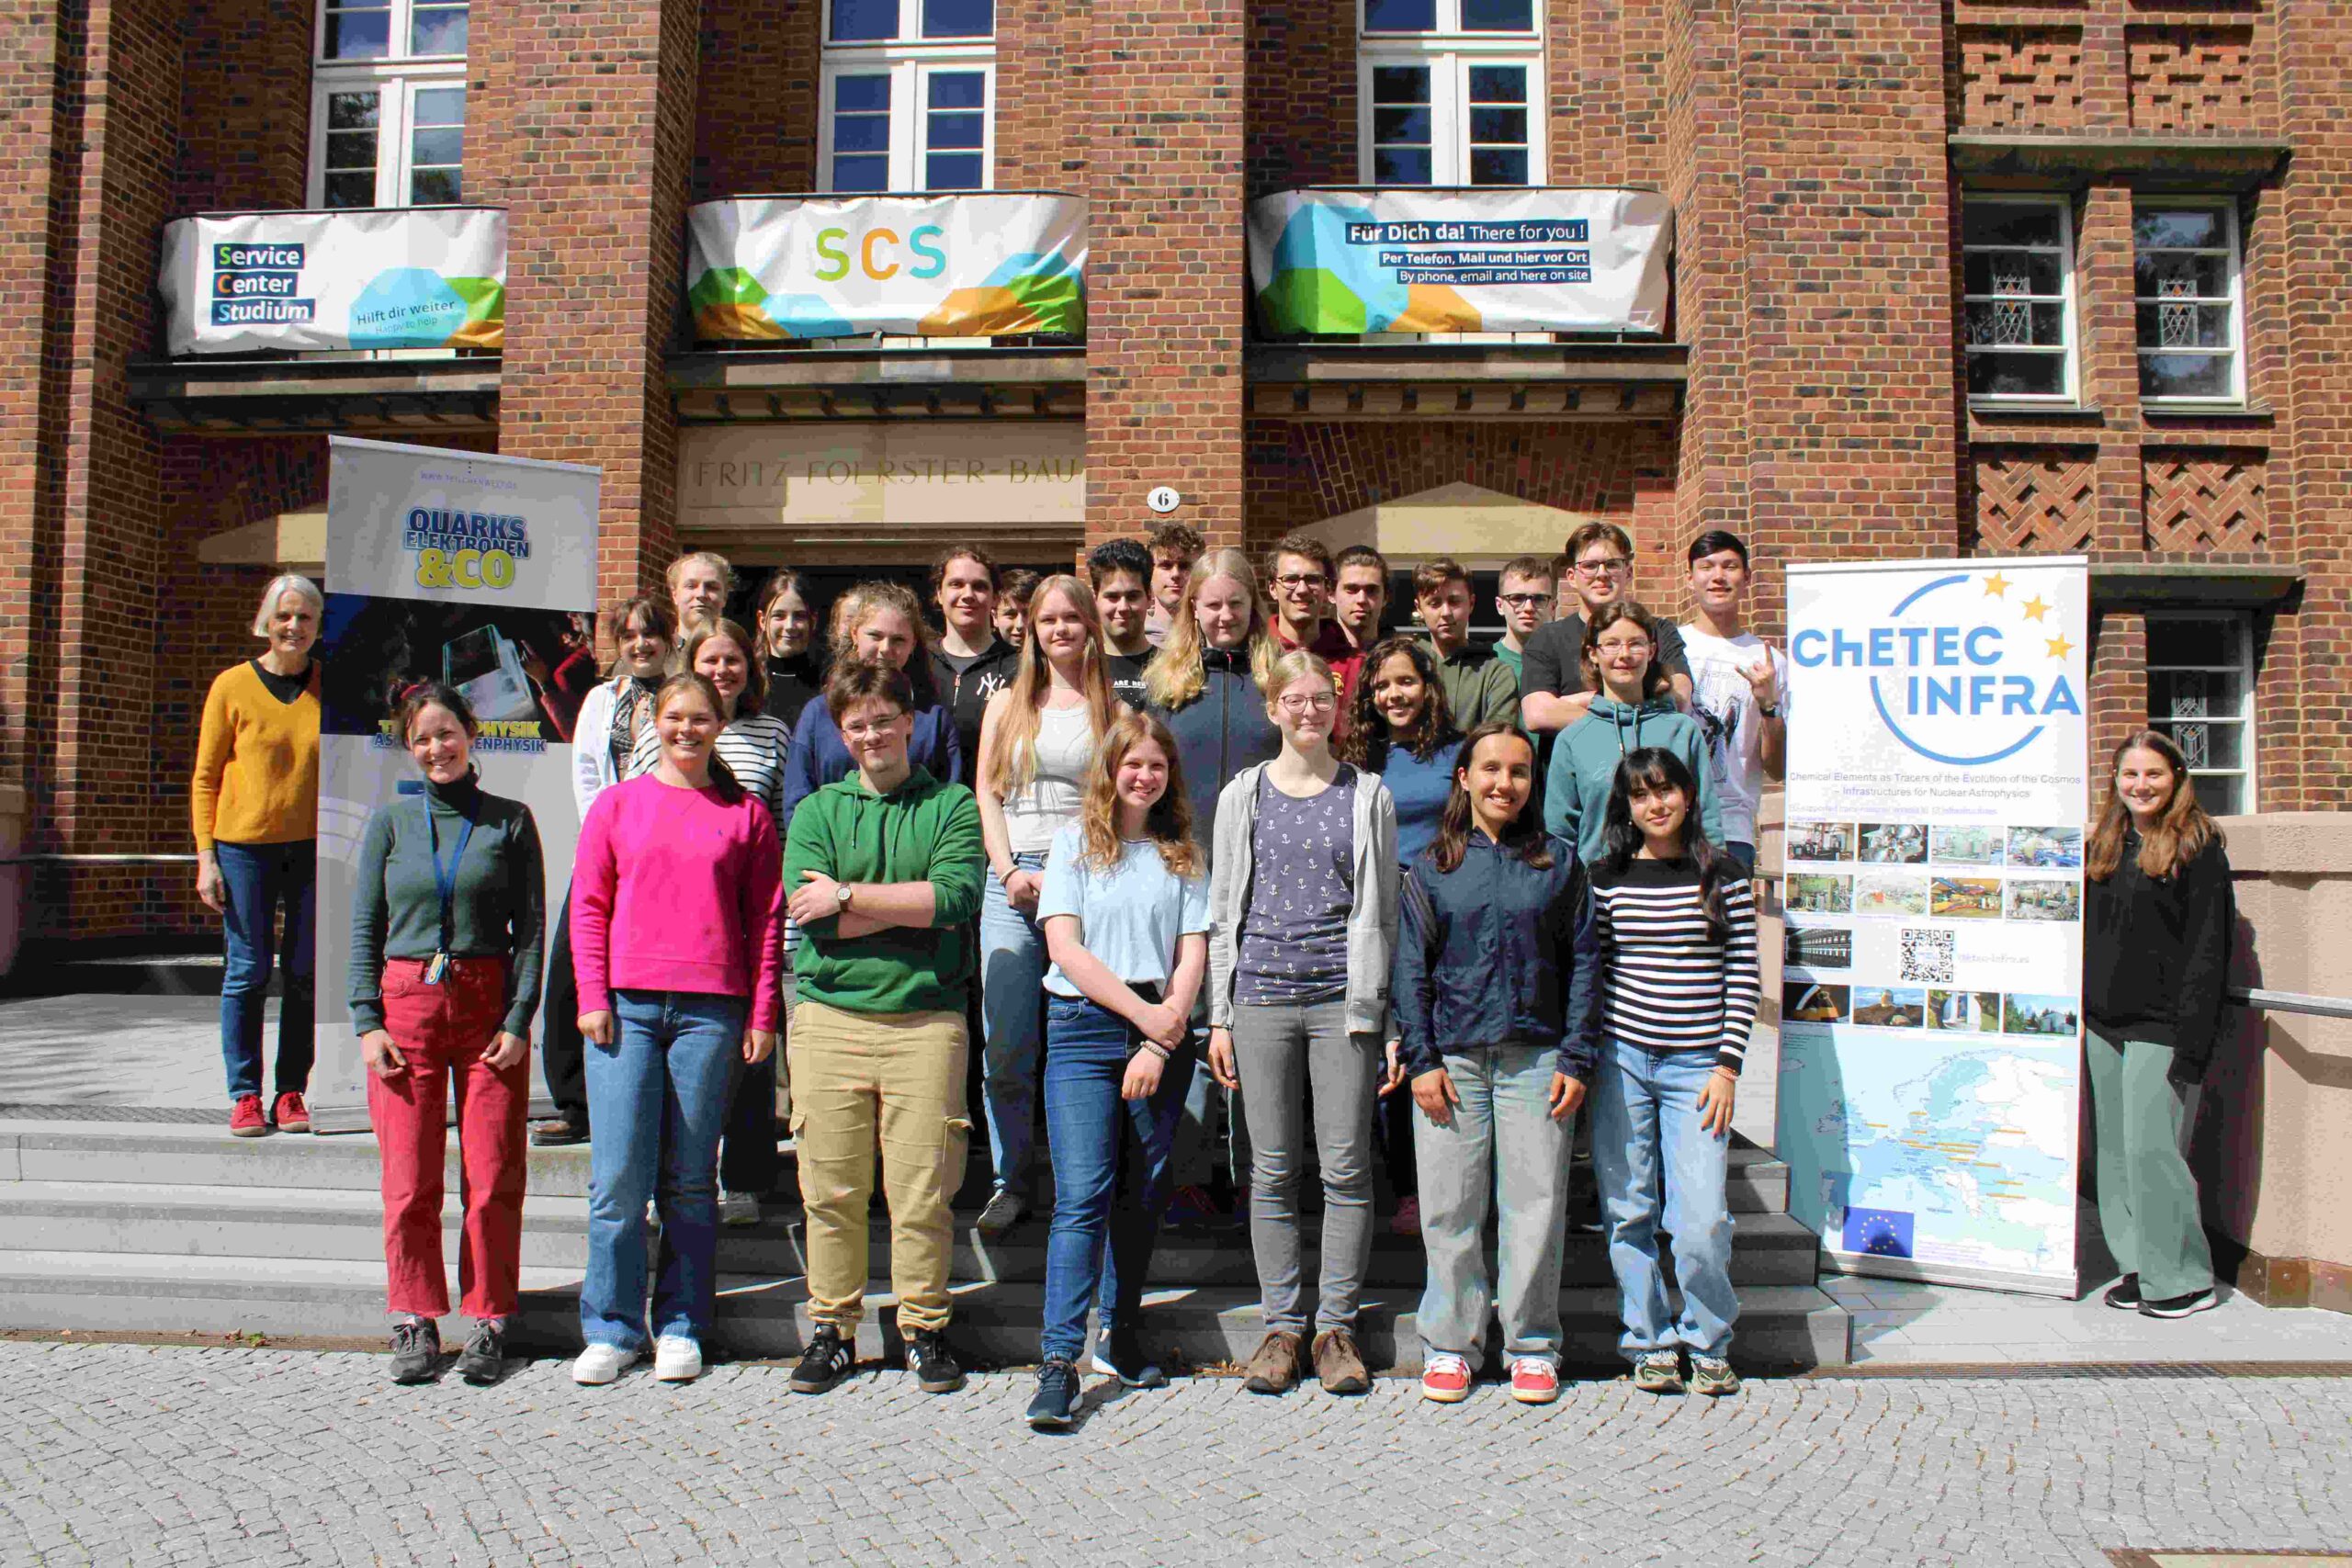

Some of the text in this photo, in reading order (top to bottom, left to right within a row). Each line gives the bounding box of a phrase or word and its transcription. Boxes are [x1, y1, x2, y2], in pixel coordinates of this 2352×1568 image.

[1351, 222, 1382, 242] Für
[1388, 224, 1430, 241] Dich
[1436, 223, 1464, 240] da!
[1470, 225, 1515, 240] There
[1520, 224, 1546, 239] for
[1546, 228, 1576, 243] you
[220, 246, 300, 265] Service
[815, 225, 946, 281] SCS
[1383, 252, 1587, 265] Per Telefon, Mail und hier vor Ort
[218, 275, 293, 294] Center
[1400, 270, 1588, 284] By phone, email and here on site
[219, 300, 310, 322] Studium
[357, 301, 455, 325] Hilft dir weiter
[697, 460, 786, 487] FRITZ
[1158, 492, 1169, 506] 6
[409, 508, 526, 540] QUARKS
[404, 530, 530, 558] ELEKTRONEN
[417, 548, 514, 588] &CO
[1792, 626, 2004, 668] ChETEC
[1907, 674, 2082, 716] INFRA
[1790, 773, 1830, 781] Chemical
[1834, 773, 1876, 781] Elements
[1894, 773, 1929, 782] Tracers
[1933, 773, 1942, 783] of
[1944, 774, 1959, 783] the
[1962, 774, 2007, 784] Evolution
[2009, 774, 2019, 784] of
[2021, 774, 2038, 784] the
[2041, 774, 2080, 784] Cosmos
[1843, 786, 1911, 796] Infrastructures
[1915, 787, 1928, 796] for
[1930, 788, 1967, 797] Nuclear
[1969, 788, 2030, 798] Astrophysics
